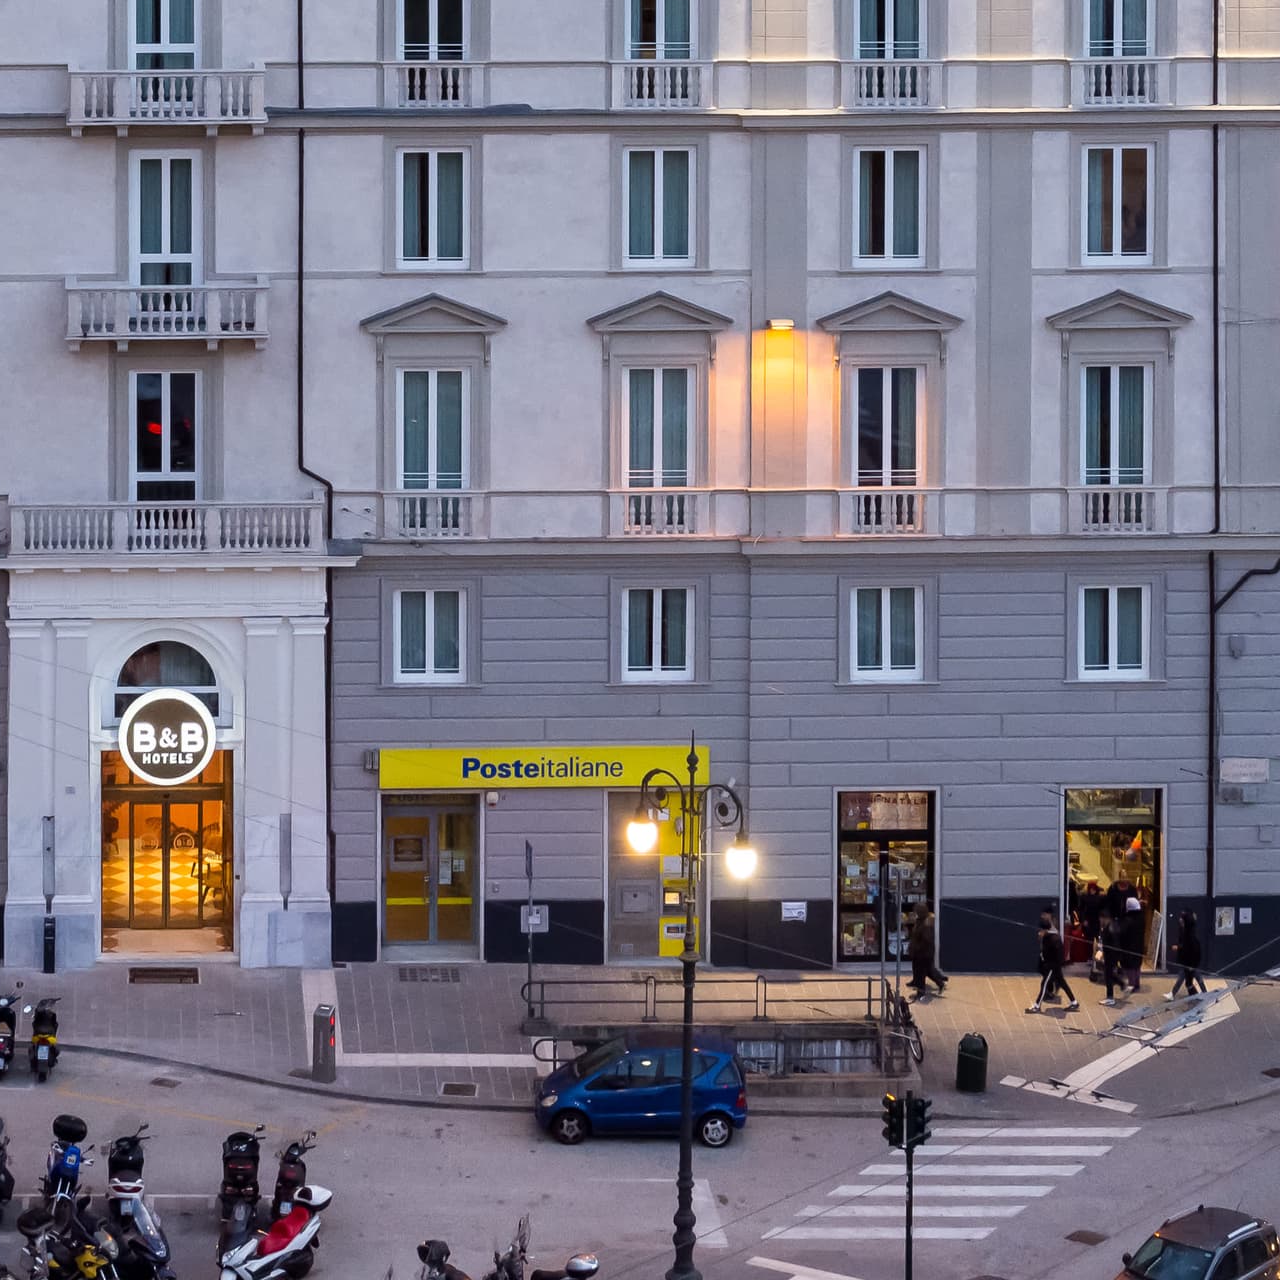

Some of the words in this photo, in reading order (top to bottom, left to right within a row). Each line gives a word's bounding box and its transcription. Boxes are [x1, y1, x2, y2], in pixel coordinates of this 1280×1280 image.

[133, 722, 205, 753] B&B
[142, 752, 194, 765] HOTELS
[461, 756, 624, 779] Posteitaliane
